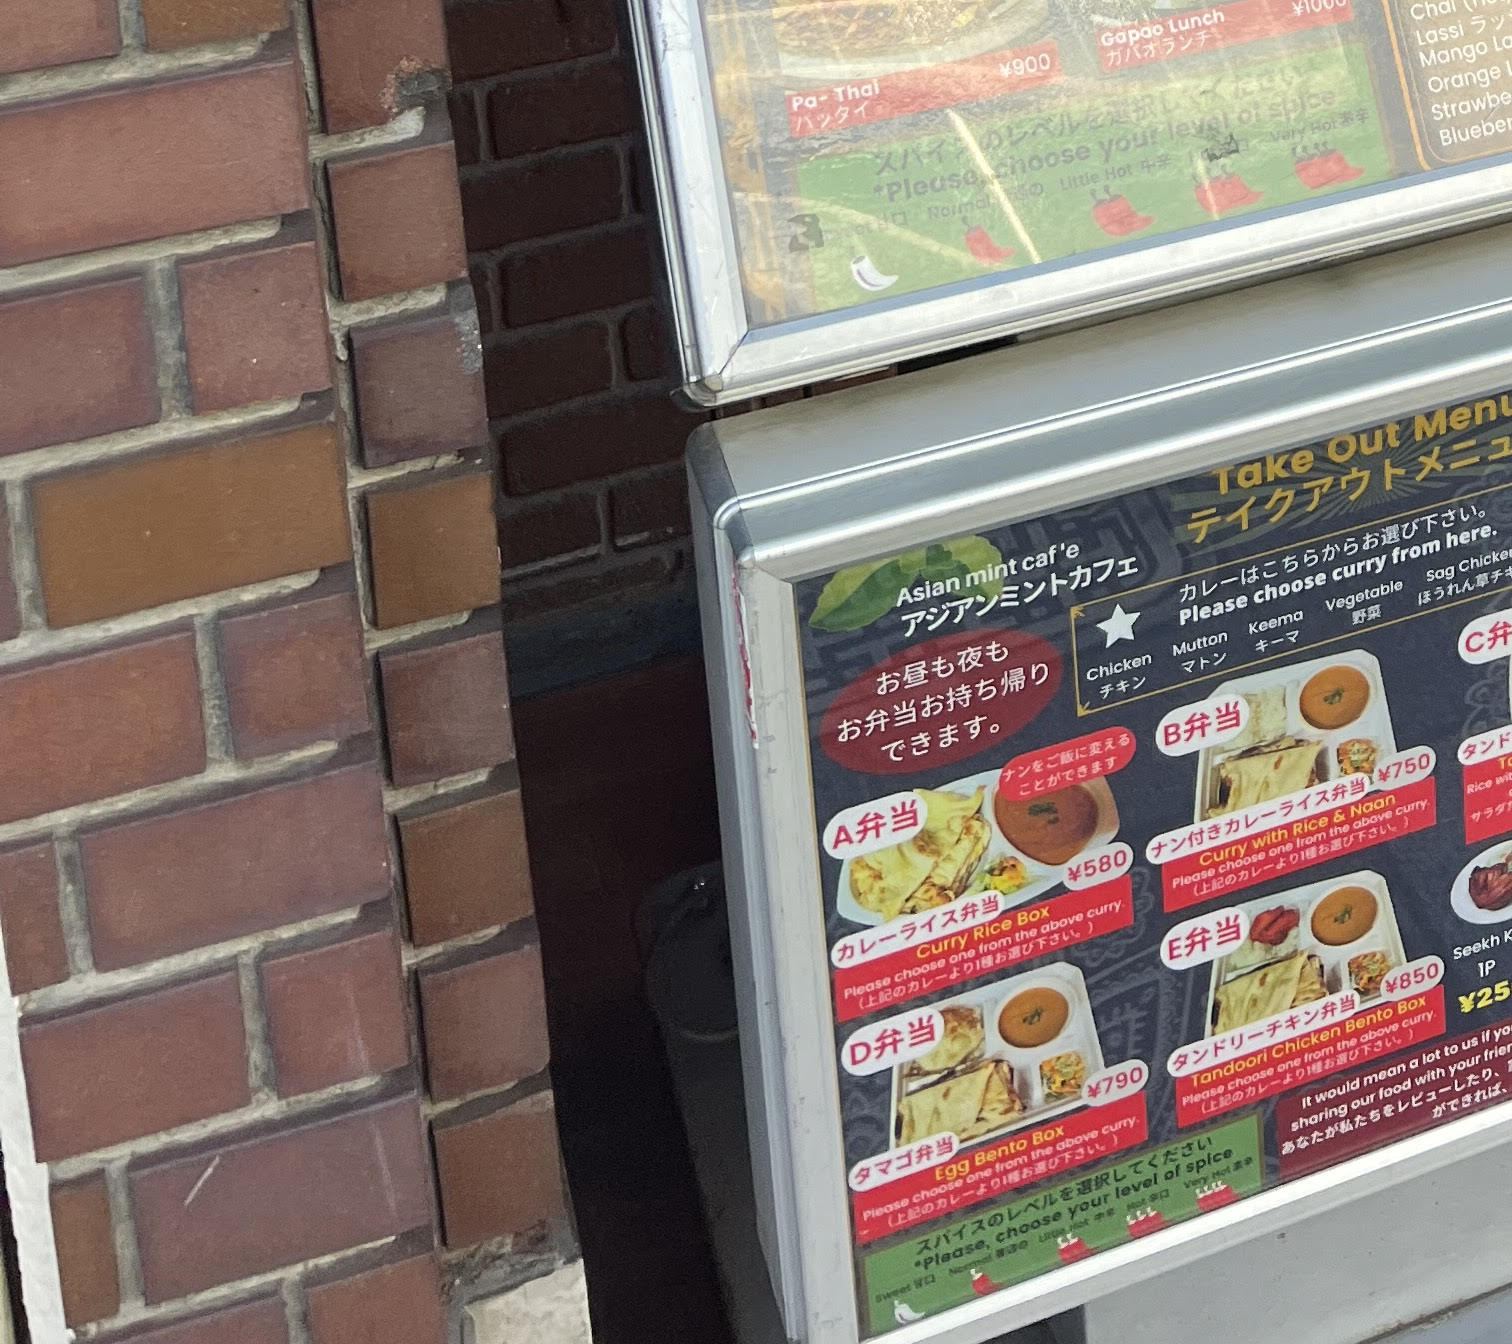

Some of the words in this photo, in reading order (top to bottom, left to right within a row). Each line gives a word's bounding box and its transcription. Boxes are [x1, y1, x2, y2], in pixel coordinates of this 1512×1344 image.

[1415, 22, 1463, 45] Lassi
[1211, 445, 1315, 494] Take
[1327, 423, 1399, 464] Out
[900, 556, 1139, 637] アジアンミントカフェ
[876, 640, 1010, 695] お昼も夜も
[838, 663, 1050, 742] お弁当お持ち帰り
[1163, 703, 1242, 747] B弁当
[1378, 753, 1431, 783] ¥750
[832, 799, 922, 850] A弁当
[1067, 850, 1129, 882] ¥580
[837, 894, 1000, 964] カレーライス弁当
[916, 928, 969, 959] Curry
[974, 918, 1012, 943] Rice
[1017, 906, 1049, 928] Box
[1168, 916, 1242, 962] E弁当
[1453, 934, 1500, 961] Seekh
[1385, 963, 1439, 993] ¥850
[850, 1016, 937, 1066] D弁当
